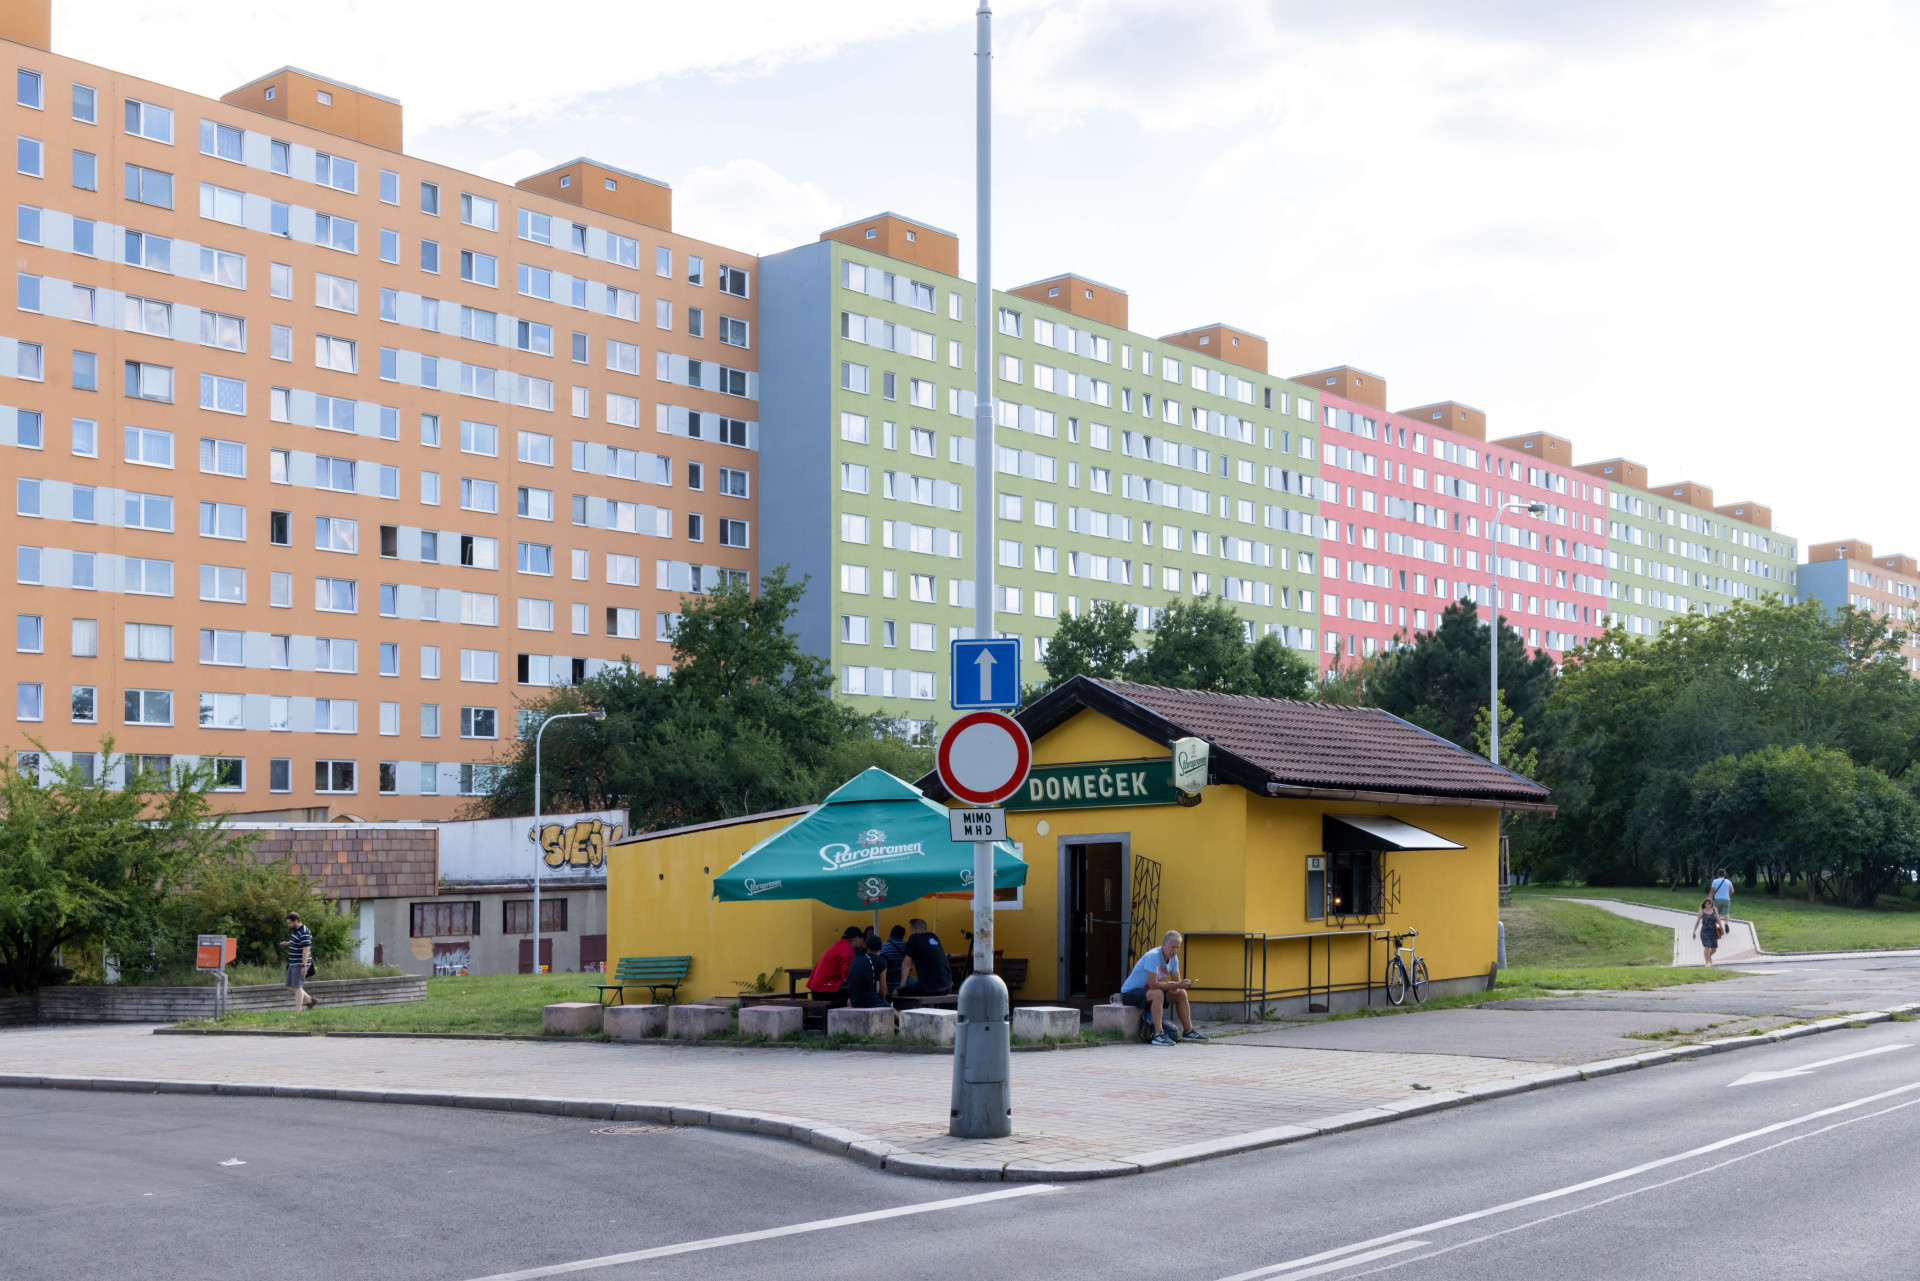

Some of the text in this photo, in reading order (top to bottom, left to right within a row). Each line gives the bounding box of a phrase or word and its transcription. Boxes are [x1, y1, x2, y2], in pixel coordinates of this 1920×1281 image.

[1029, 768, 1149, 801] DOMEČEK
[963, 812, 991, 823] MIMO
[964, 825, 992, 836] MHD
[819, 843, 925, 871] Staropramen
